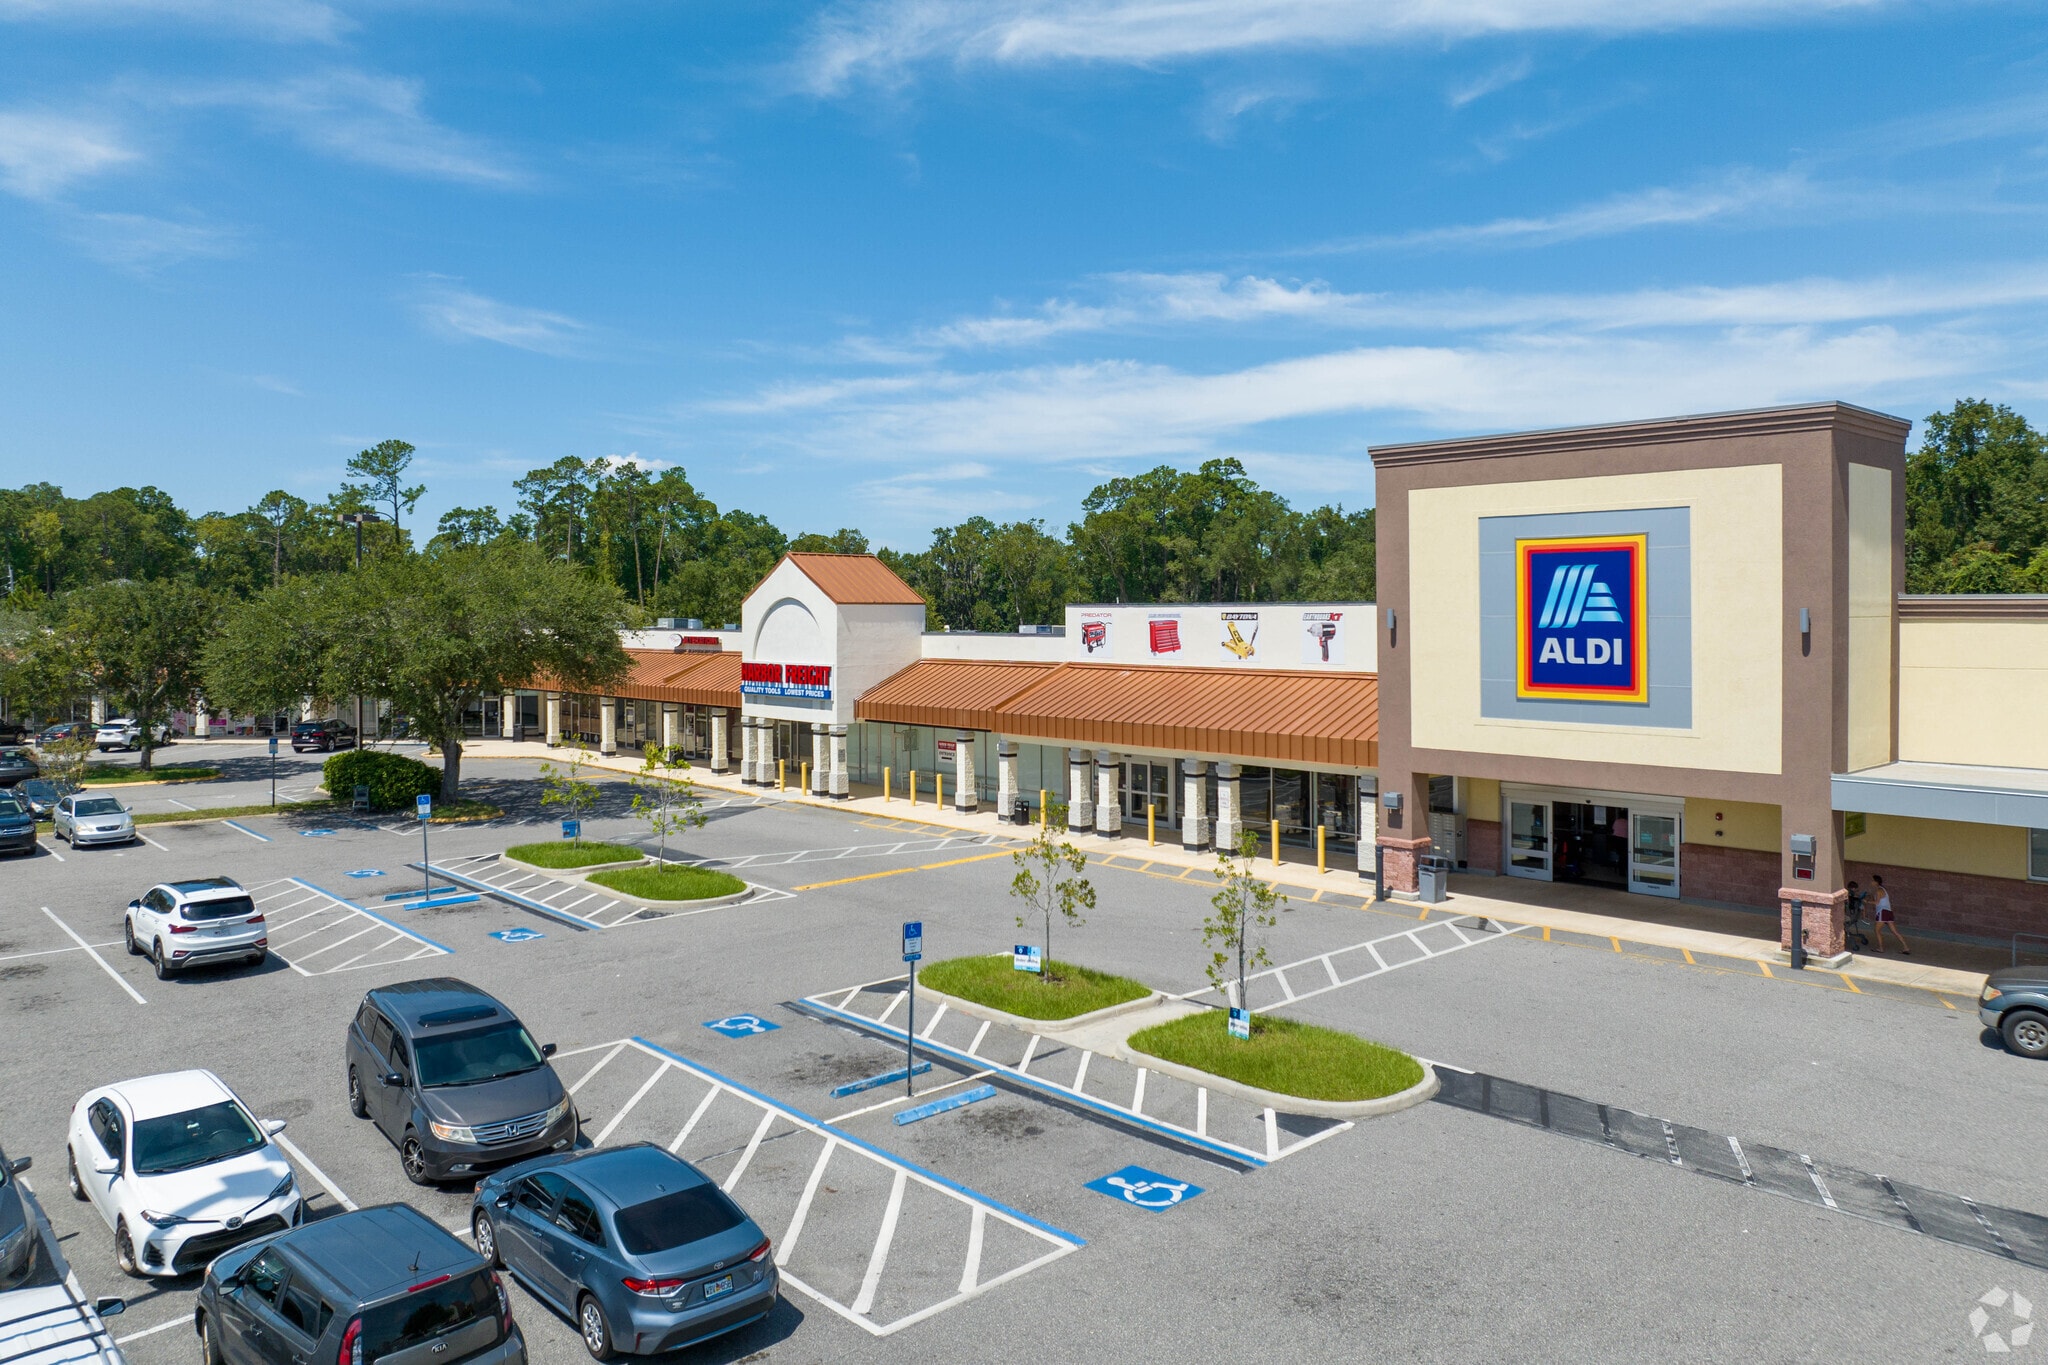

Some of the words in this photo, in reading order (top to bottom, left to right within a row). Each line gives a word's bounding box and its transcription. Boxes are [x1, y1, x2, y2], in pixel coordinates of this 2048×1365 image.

[1539, 637, 1623, 665] ALDI
[742, 663, 782, 683] HARBOR
[785, 665, 832, 686] FREIGHT
[765, 687, 781, 695] TOOLS
[784, 688, 805, 696] LOWEST
[805, 690, 825, 698] PRICES
[434, 1343, 448, 1353] KIA
